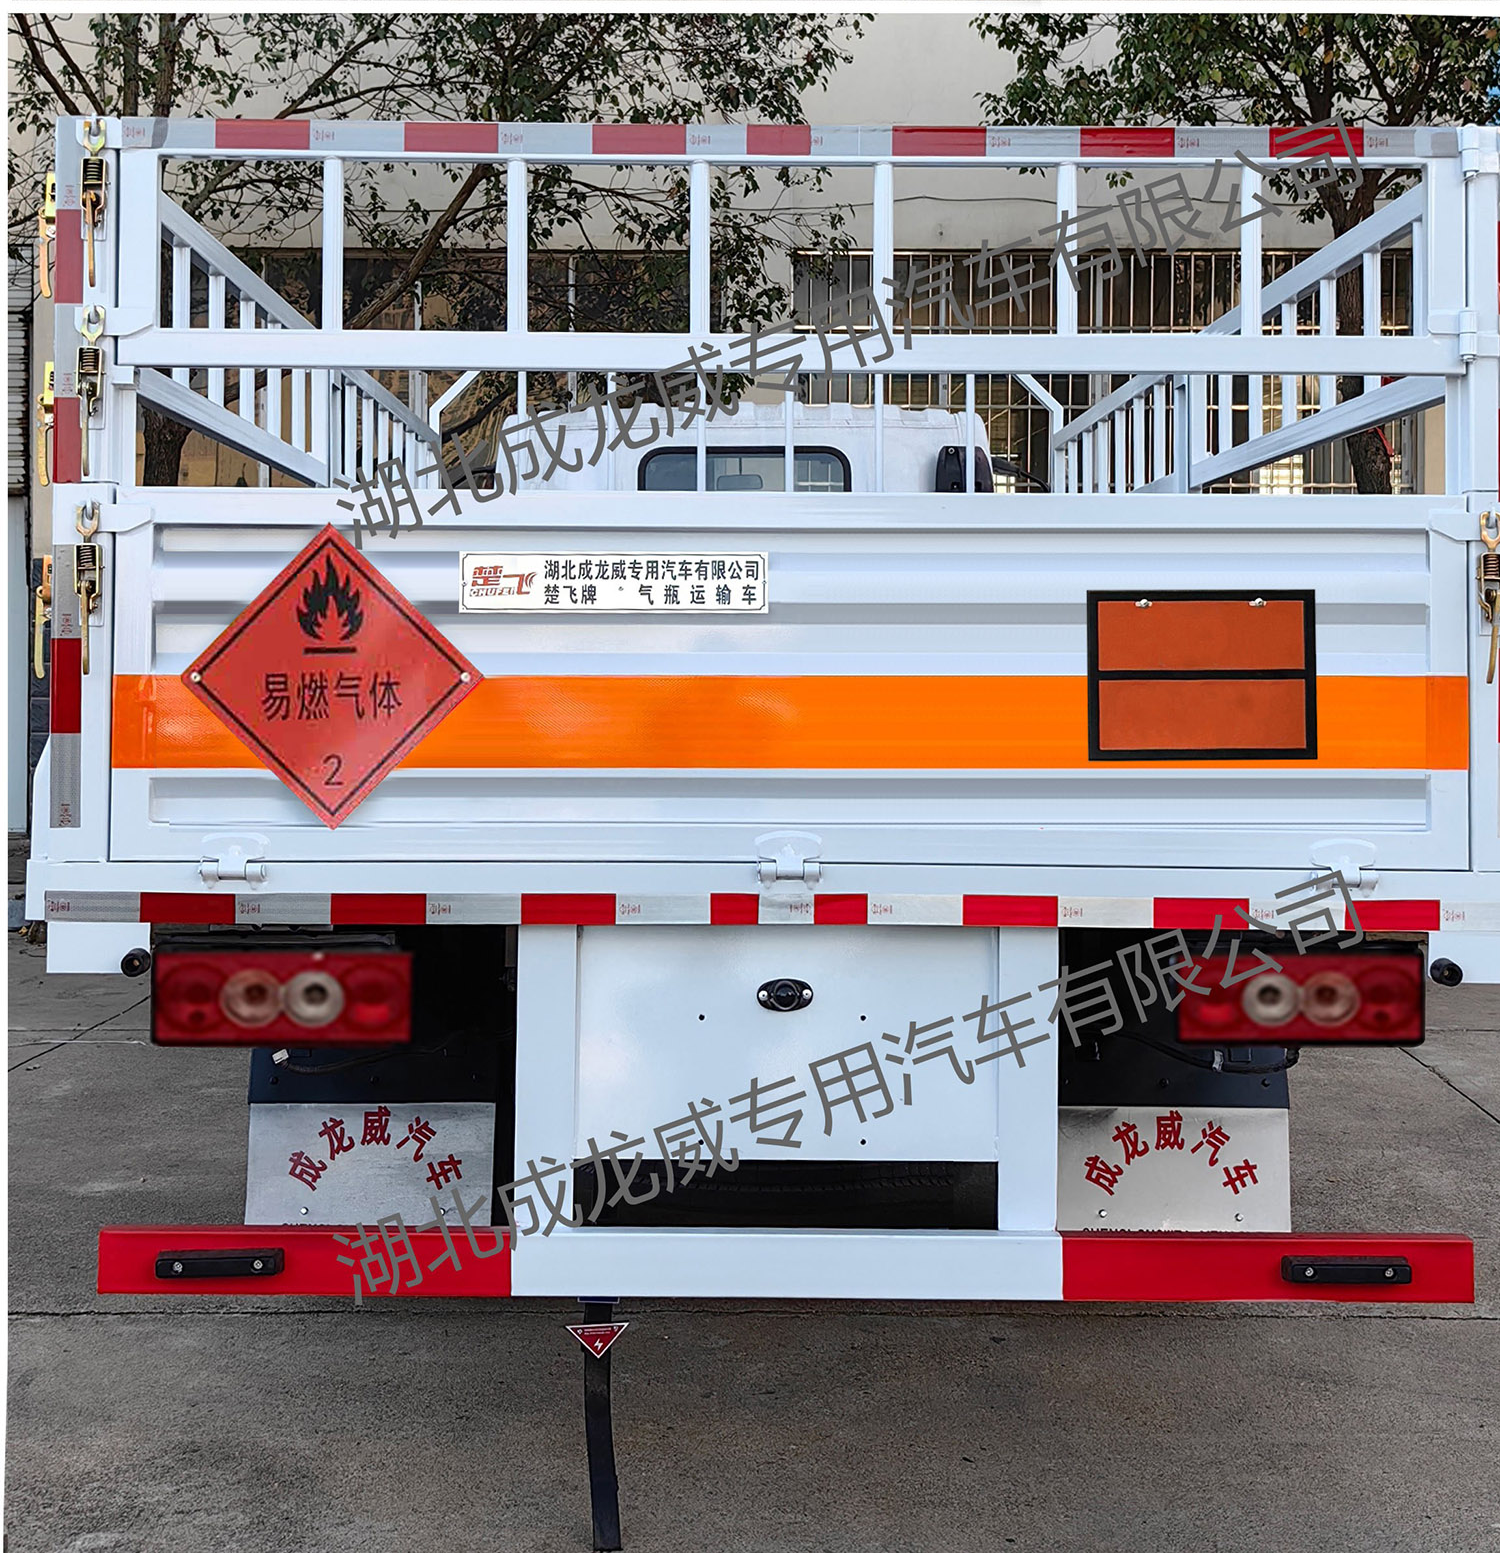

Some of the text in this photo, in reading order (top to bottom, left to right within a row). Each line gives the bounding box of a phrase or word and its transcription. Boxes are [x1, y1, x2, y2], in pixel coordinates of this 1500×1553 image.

[543, 559, 760, 581] 湖北成龙威专用汽车有限公司
[543, 584, 598, 605] 楚飞牌
[262, 671, 402, 722] 易燃气体
[322, 753, 345, 786] 2
[288, 1105, 463, 1192] 成龙威汽车
[1083, 1109, 1259, 1196] 成龙威汽车
